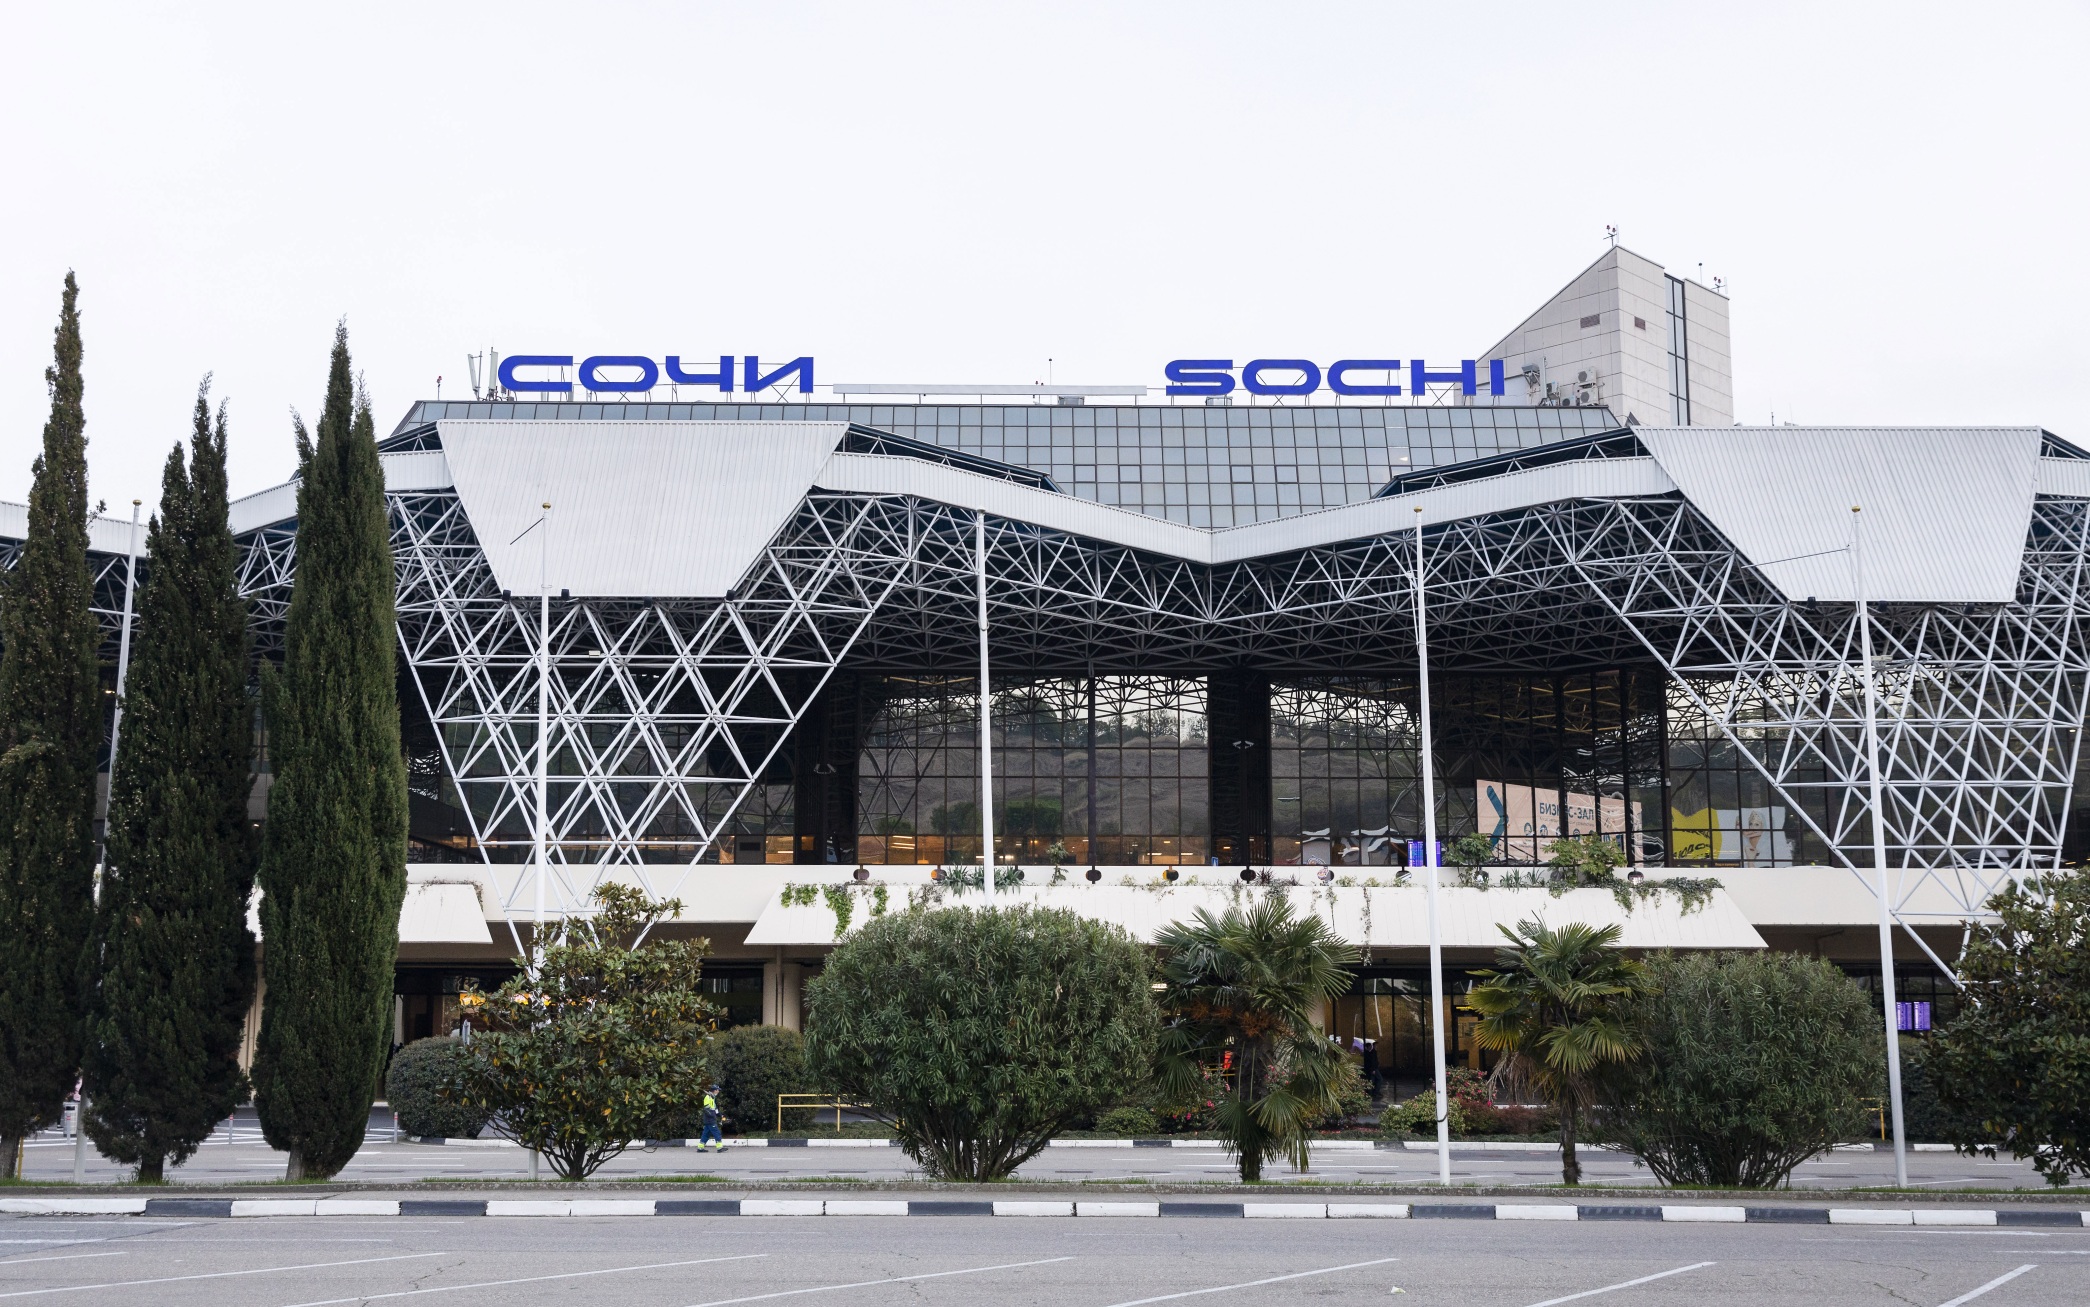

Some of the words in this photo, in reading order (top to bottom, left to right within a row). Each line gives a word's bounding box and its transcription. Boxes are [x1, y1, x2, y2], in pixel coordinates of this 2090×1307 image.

[497, 355, 814, 393] СОЧИ
[1165, 359, 1505, 396] SOCHI
[1539, 802, 1595, 821] БИЗС-ЗАЛ
